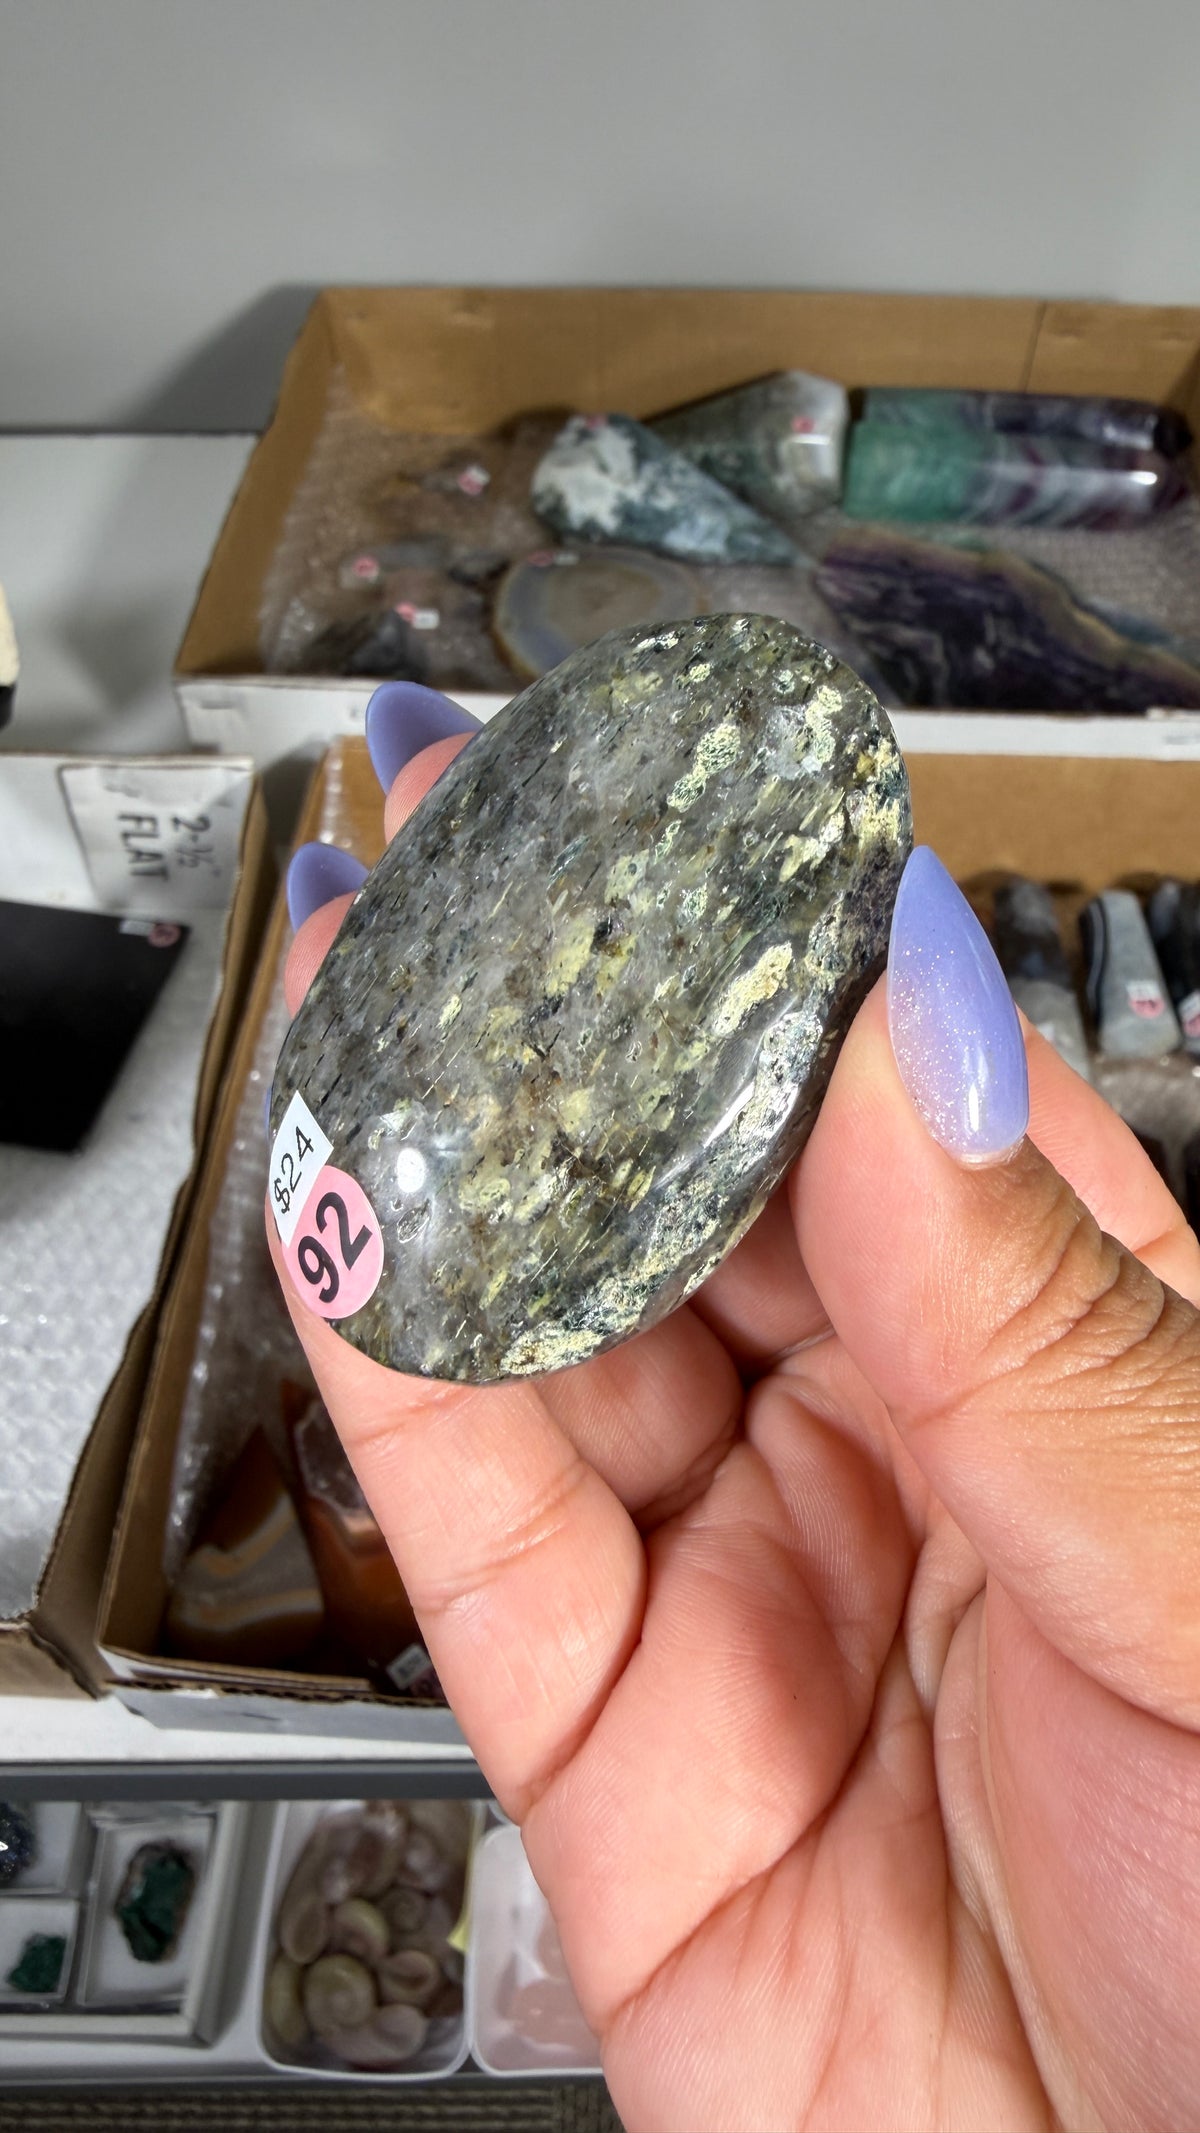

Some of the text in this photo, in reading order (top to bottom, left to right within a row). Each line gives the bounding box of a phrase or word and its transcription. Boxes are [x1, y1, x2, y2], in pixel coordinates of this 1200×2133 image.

[117, 813, 169, 881] FLAT
[273, 1125, 314, 1214] $24
[297, 1191, 373, 1304] 92
